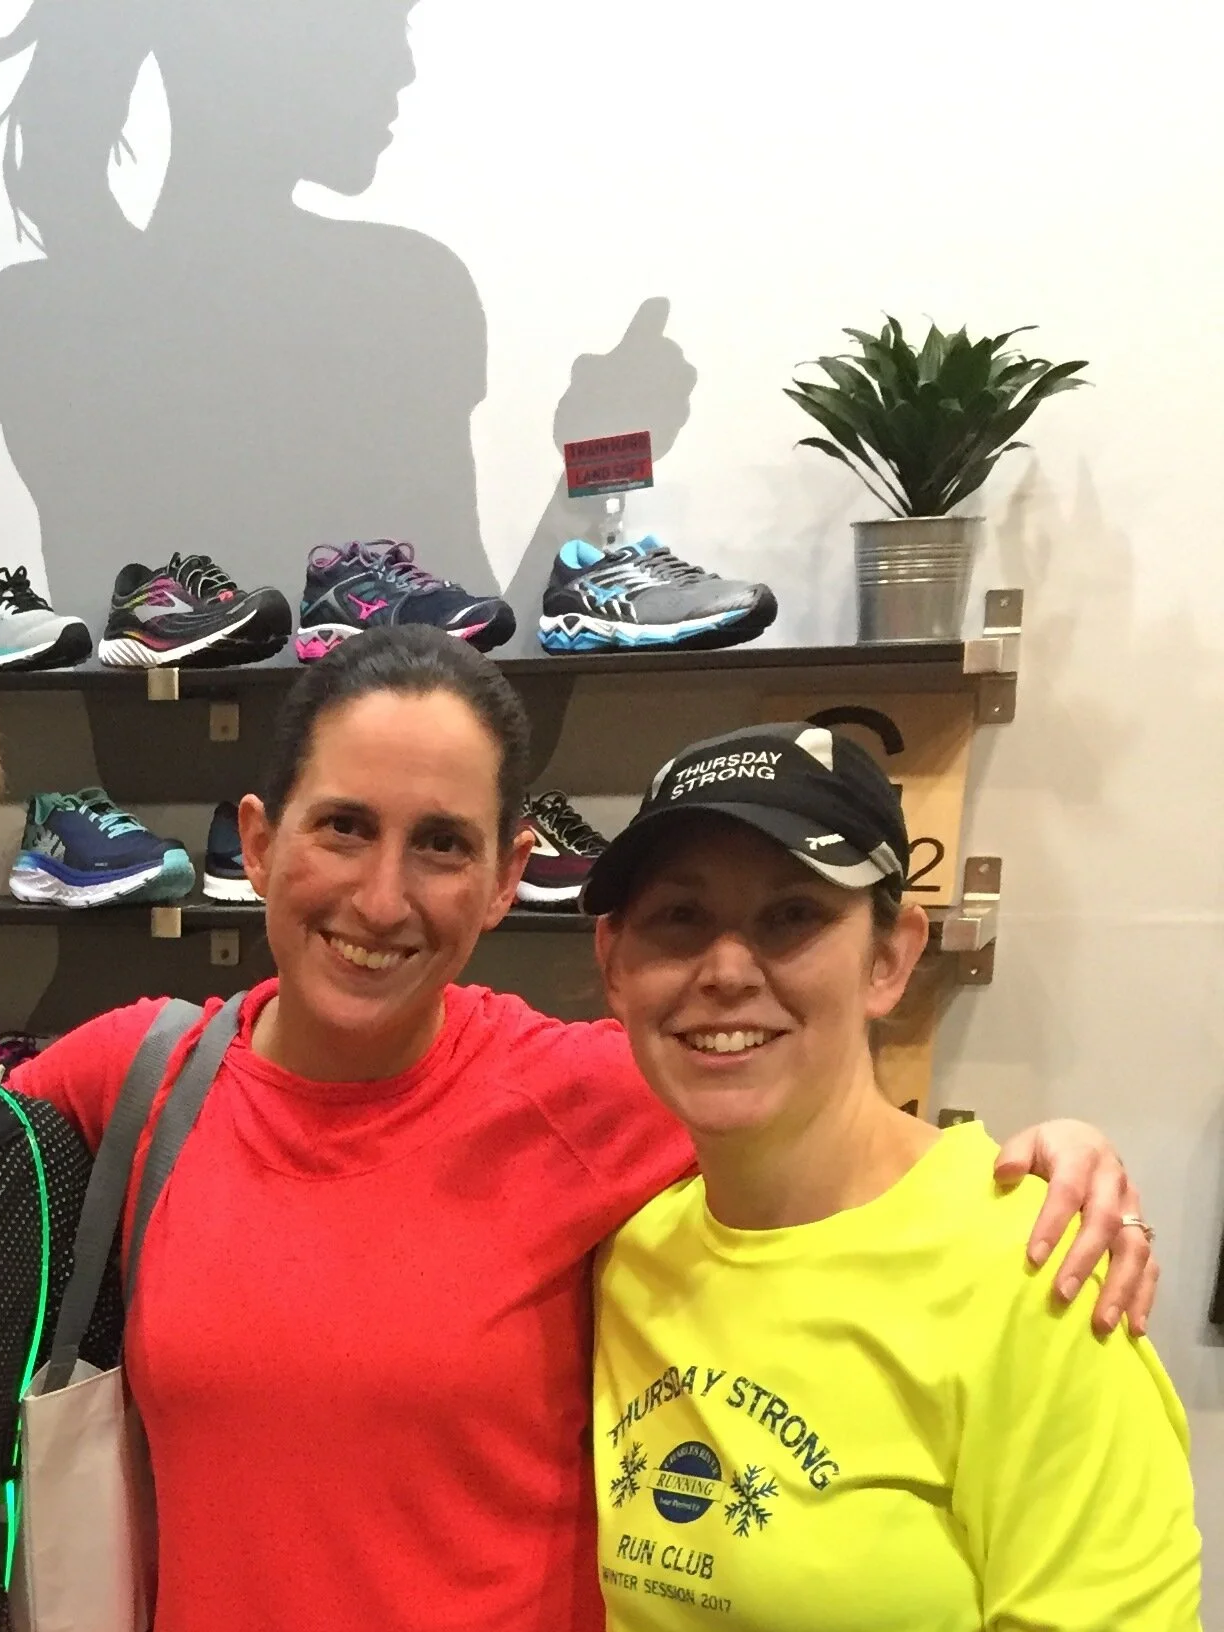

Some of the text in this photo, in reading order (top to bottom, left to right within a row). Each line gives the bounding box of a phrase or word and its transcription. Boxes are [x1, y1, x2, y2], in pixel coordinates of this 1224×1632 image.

[669, 764, 776, 801] STRONG
[675, 750, 783, 783] THURSDAY
[606, 1365, 840, 1491] THURSDAY STRONG
[656, 1472, 715, 1497] RUNNING
[616, 1533, 715, 1580] RUN CLUB
[602, 1565, 732, 1614] WINTER SESSION 2017
